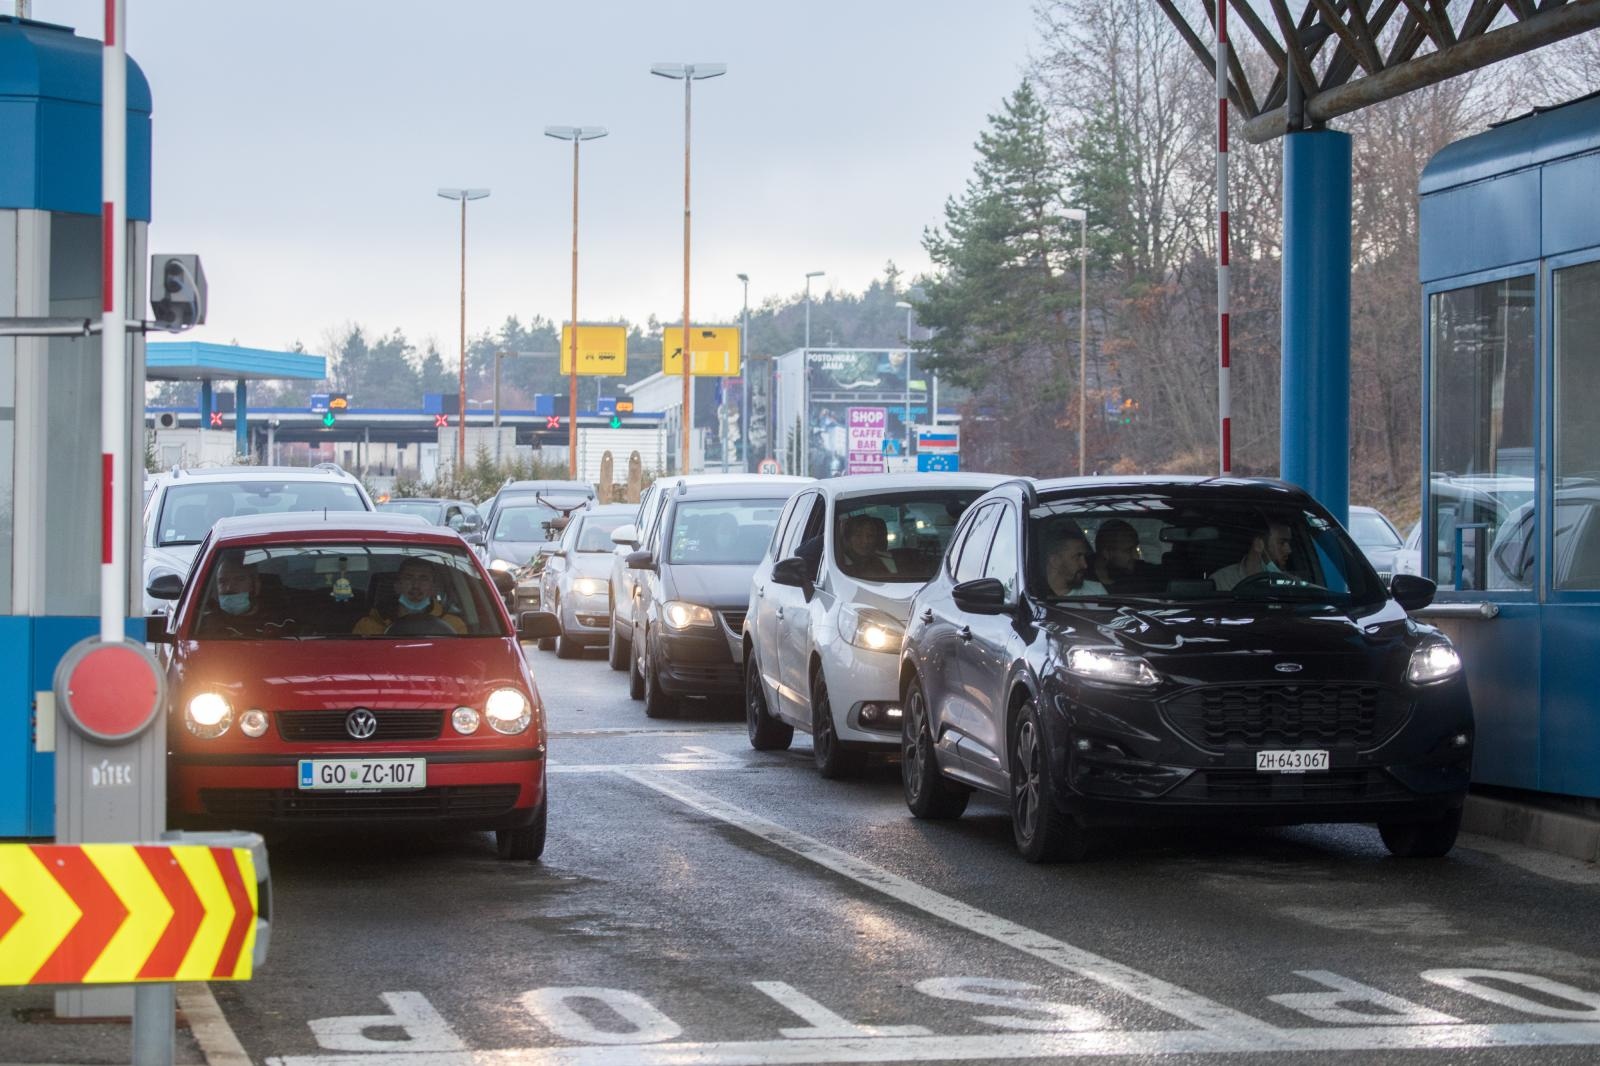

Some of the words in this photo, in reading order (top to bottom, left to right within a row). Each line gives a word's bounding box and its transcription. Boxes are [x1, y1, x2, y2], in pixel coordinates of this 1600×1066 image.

[852, 411, 884, 423] SHOP
[852, 429, 882, 439] CAFFE
[857, 440, 877, 449] BAR
[762, 464, 777, 474] 50
[321, 764, 346, 783] GO
[361, 763, 415, 783] ZC-107
[308, 977, 1106, 1053] STOP
